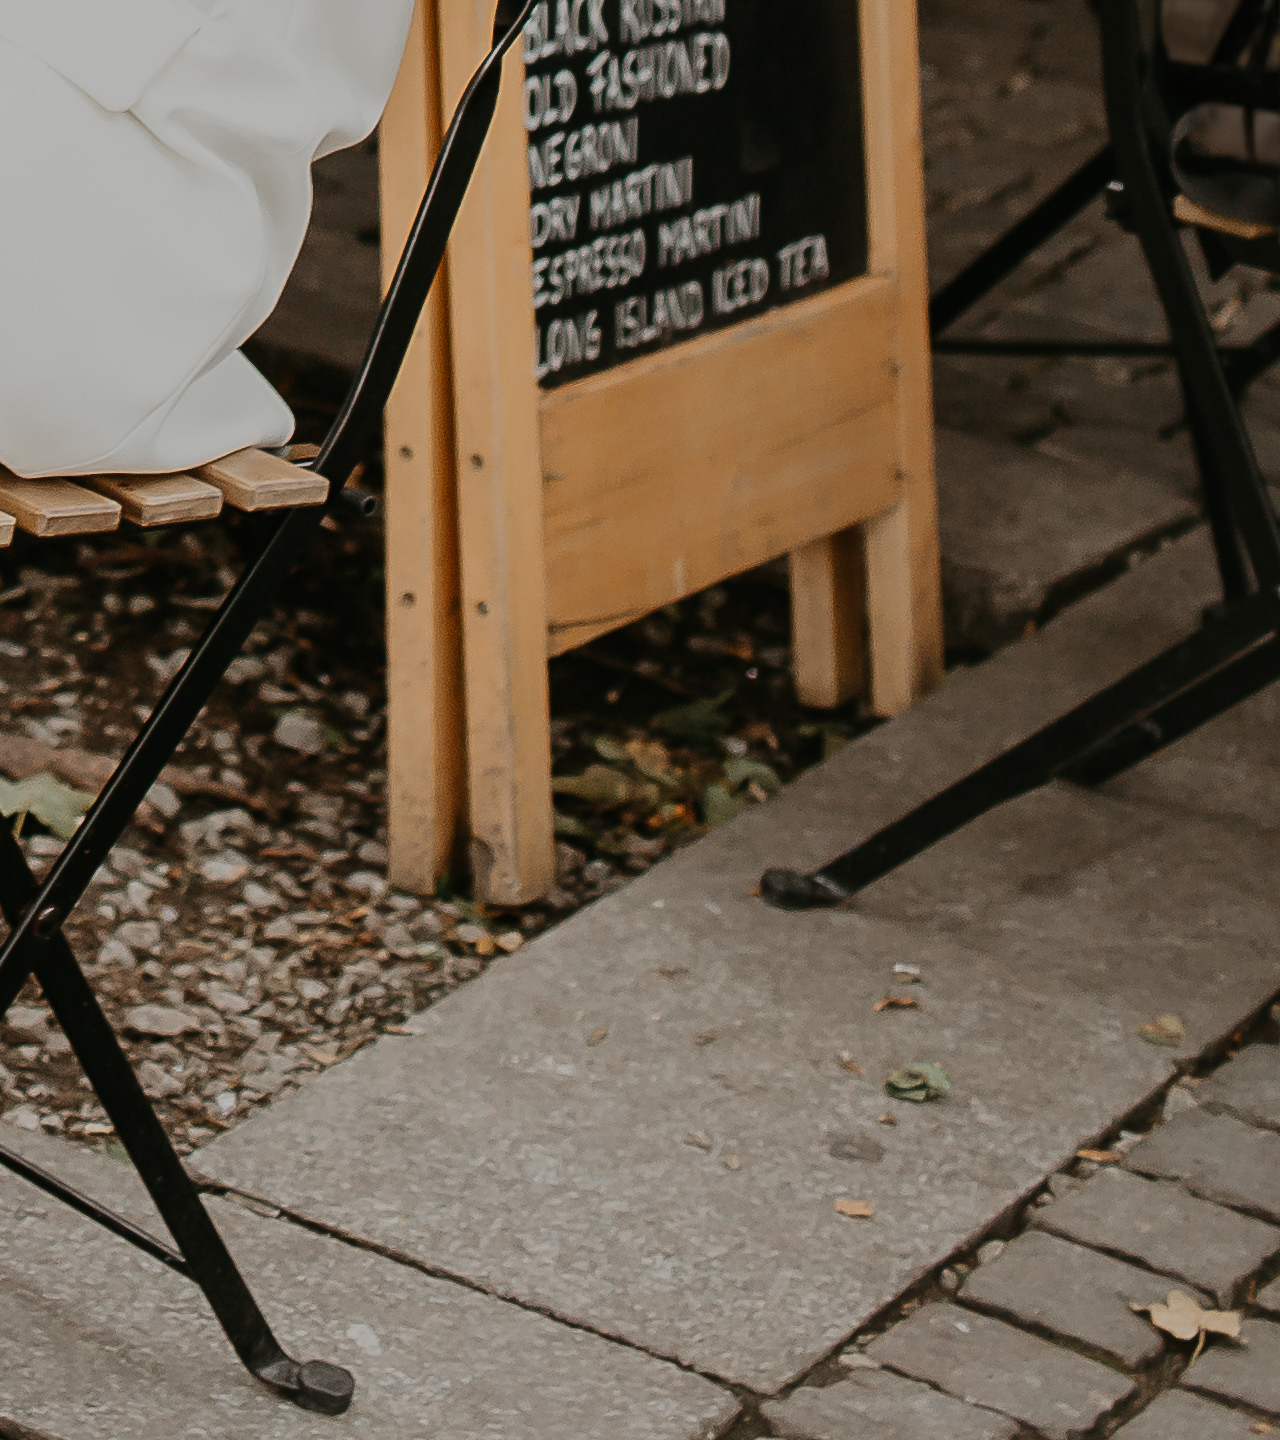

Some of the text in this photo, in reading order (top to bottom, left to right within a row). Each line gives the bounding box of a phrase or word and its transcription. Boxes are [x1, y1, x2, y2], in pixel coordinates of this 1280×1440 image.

[525, 32, 731, 131] OLD FASHIONED
[528, 116, 639, 190] NEGRONI
[530, 155, 694, 249] DRY MARTINI
[532, 192, 761, 310] ESPRESSO MARTINI
[534, 233, 830, 379] LONG ISLAND ICED TEA
